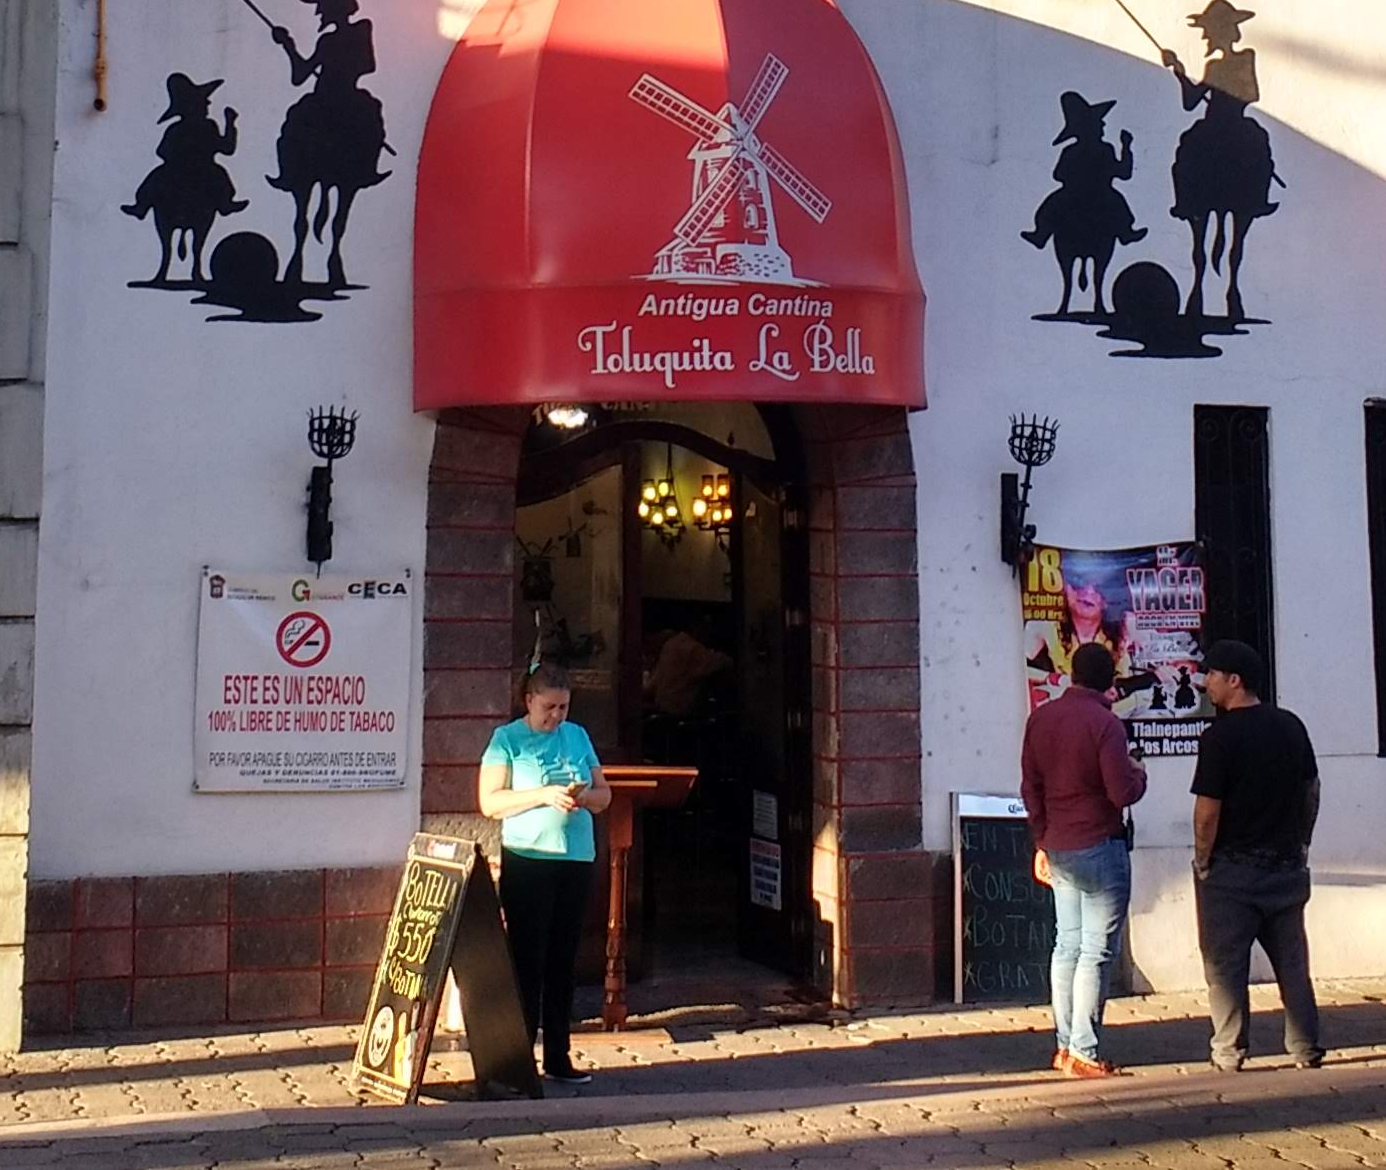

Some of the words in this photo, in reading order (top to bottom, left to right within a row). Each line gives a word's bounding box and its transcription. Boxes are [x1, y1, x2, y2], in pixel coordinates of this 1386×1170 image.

[638, 294, 739, 321] Antigua
[748, 293, 833, 317] Cantina
[578, 320, 734, 388] Toluquita
[749, 323, 799, 381] La
[804, 319, 875, 375] Bella
[348, 581, 407, 599] CECA
[224, 675, 258, 705] ESTE
[263, 675, 280, 705] ES
[284, 676, 303, 705] UN
[307, 676, 366, 706] ESPACIO
[208, 710, 236, 732] 100%
[240, 710, 273, 732] LIBRE
[276, 711, 291, 732] DE
[294, 711, 327, 732] HUMO
[330, 711, 346, 732] DE
[349, 711, 395, 733] TABACO
[209, 752, 225, 766] POR
[227, 752, 251, 766] FAVOR
[253, 752, 282, 767] APAGUE
[284, 752, 293, 767] SU
[296, 752, 329, 767] CIGARRO
[330, 752, 353, 767] ANTES
[355, 752, 365, 767] DE
[367, 752, 396, 767] ENTRAR
[1163, 738, 1199, 754] Arcos
[970, 863, 1052, 904] CONSU
[973, 905, 1047, 950] BOTA
[976, 961, 1047, 993] GRAT
